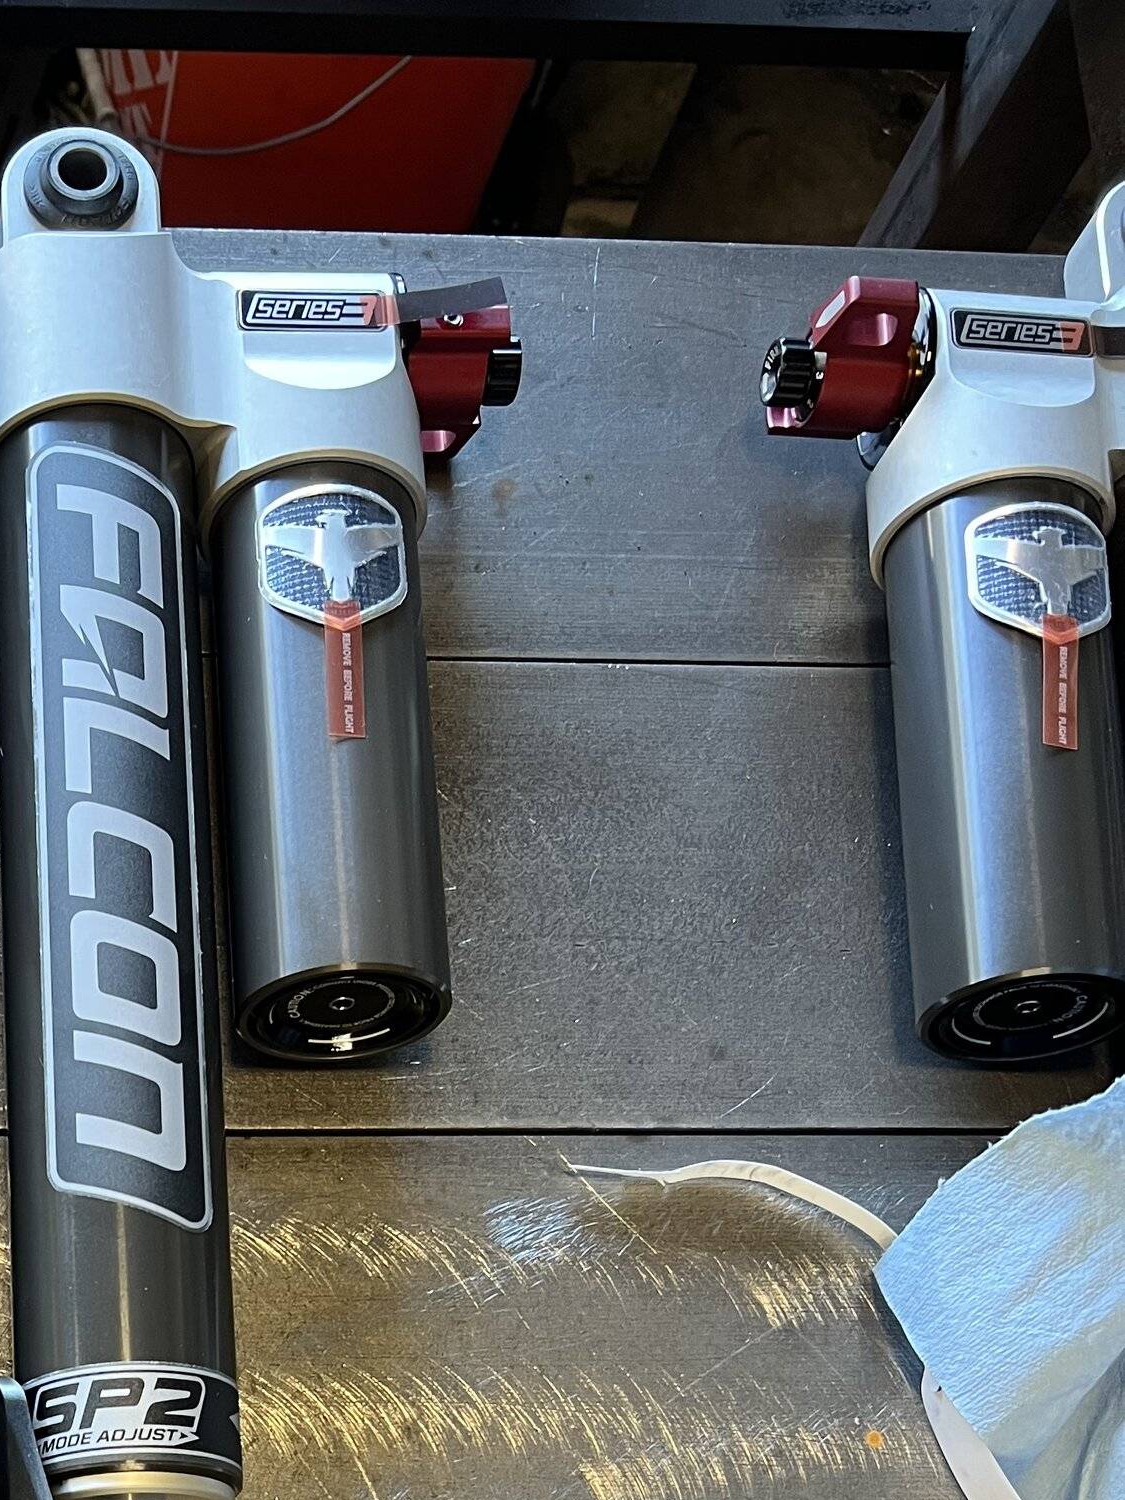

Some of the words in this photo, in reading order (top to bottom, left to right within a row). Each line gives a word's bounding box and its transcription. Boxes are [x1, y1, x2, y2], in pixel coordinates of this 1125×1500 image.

[341, 632, 352, 666] REMOVE
[1058, 646, 1068, 679] REMOVE
[343, 669, 353, 701] BEFORE
[1058, 682, 1068, 714] BEFORE
[344, 704, 355, 734] FLIGHT
[1058, 716, 1068, 745] FLIGHT
[33, 1376, 203, 1440] SP2
[41, 1431, 93, 1455] MODE
[96, 1428, 179, 1444] ADJUST
